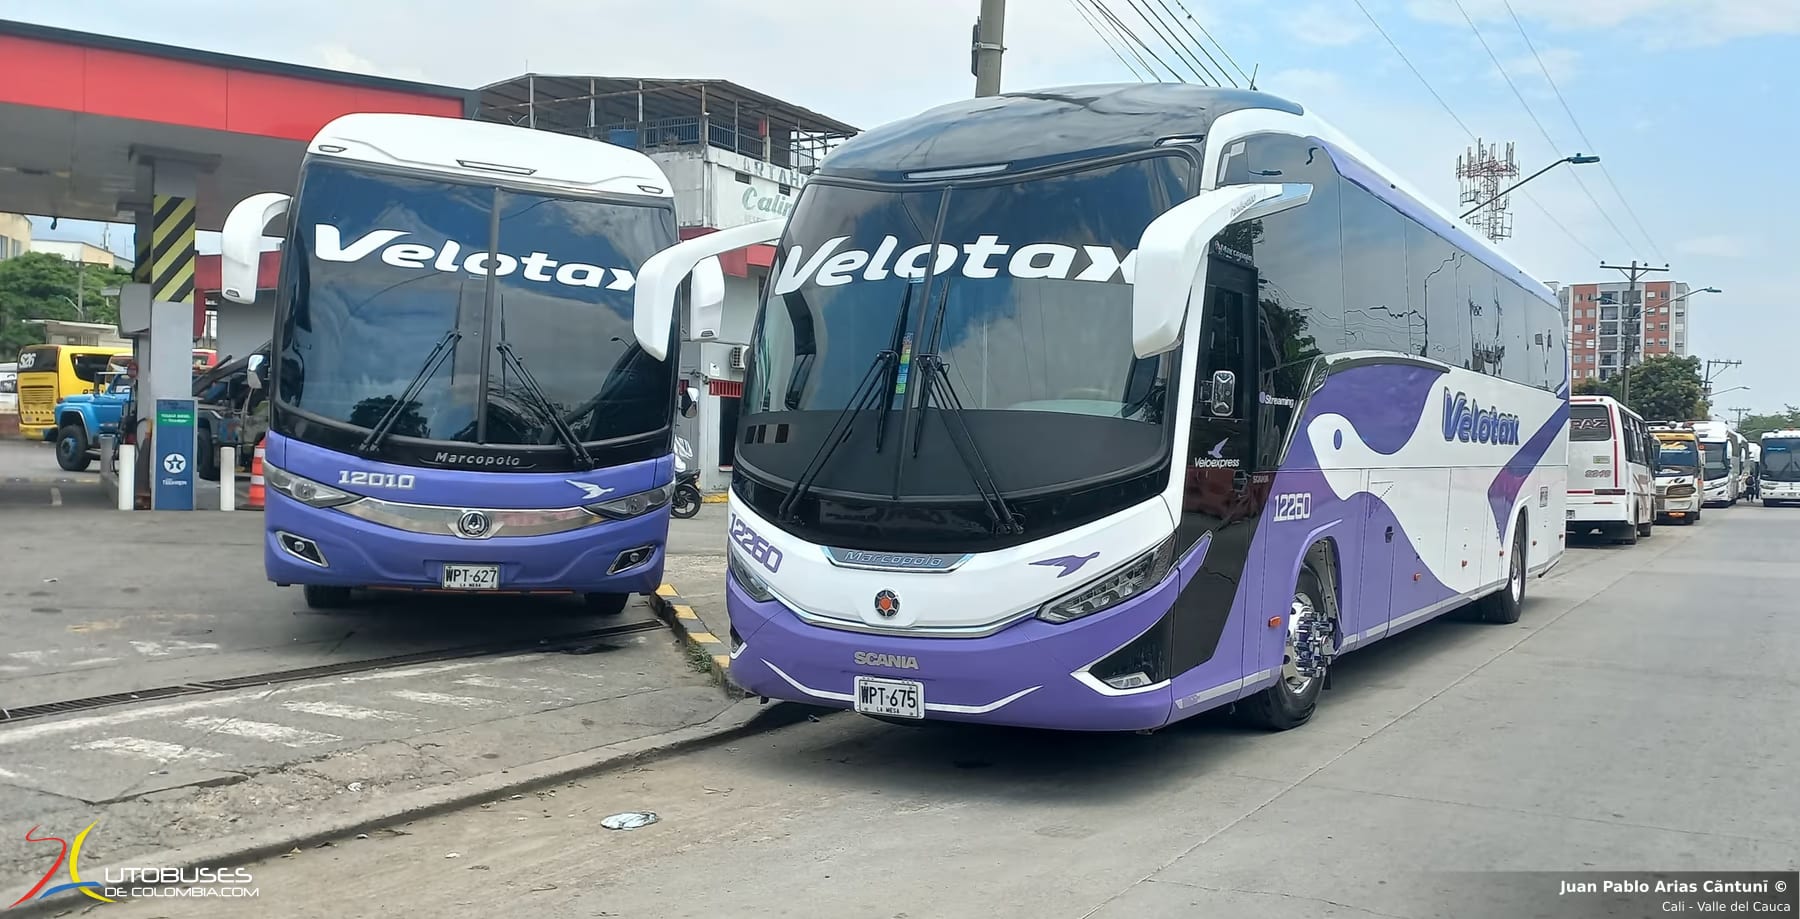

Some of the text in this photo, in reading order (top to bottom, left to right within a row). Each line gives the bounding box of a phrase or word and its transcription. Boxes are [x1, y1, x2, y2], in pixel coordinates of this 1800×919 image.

[314, 223, 636, 291] Velotax
[774, 233, 1139, 296] Velotax
[1264, 394, 1294, 408] Streaming
[1442, 385, 1520, 445] Velotax
[434, 452, 520, 466] Marcopolo
[1194, 457, 1240, 469] Veloexpress
[339, 469, 416, 490] 12010
[1273, 493, 1312, 522] 12260
[729, 511, 784, 573] 12260
[844, 550, 942, 568] Marcopolo
[854, 651, 919, 670] SCANIA
